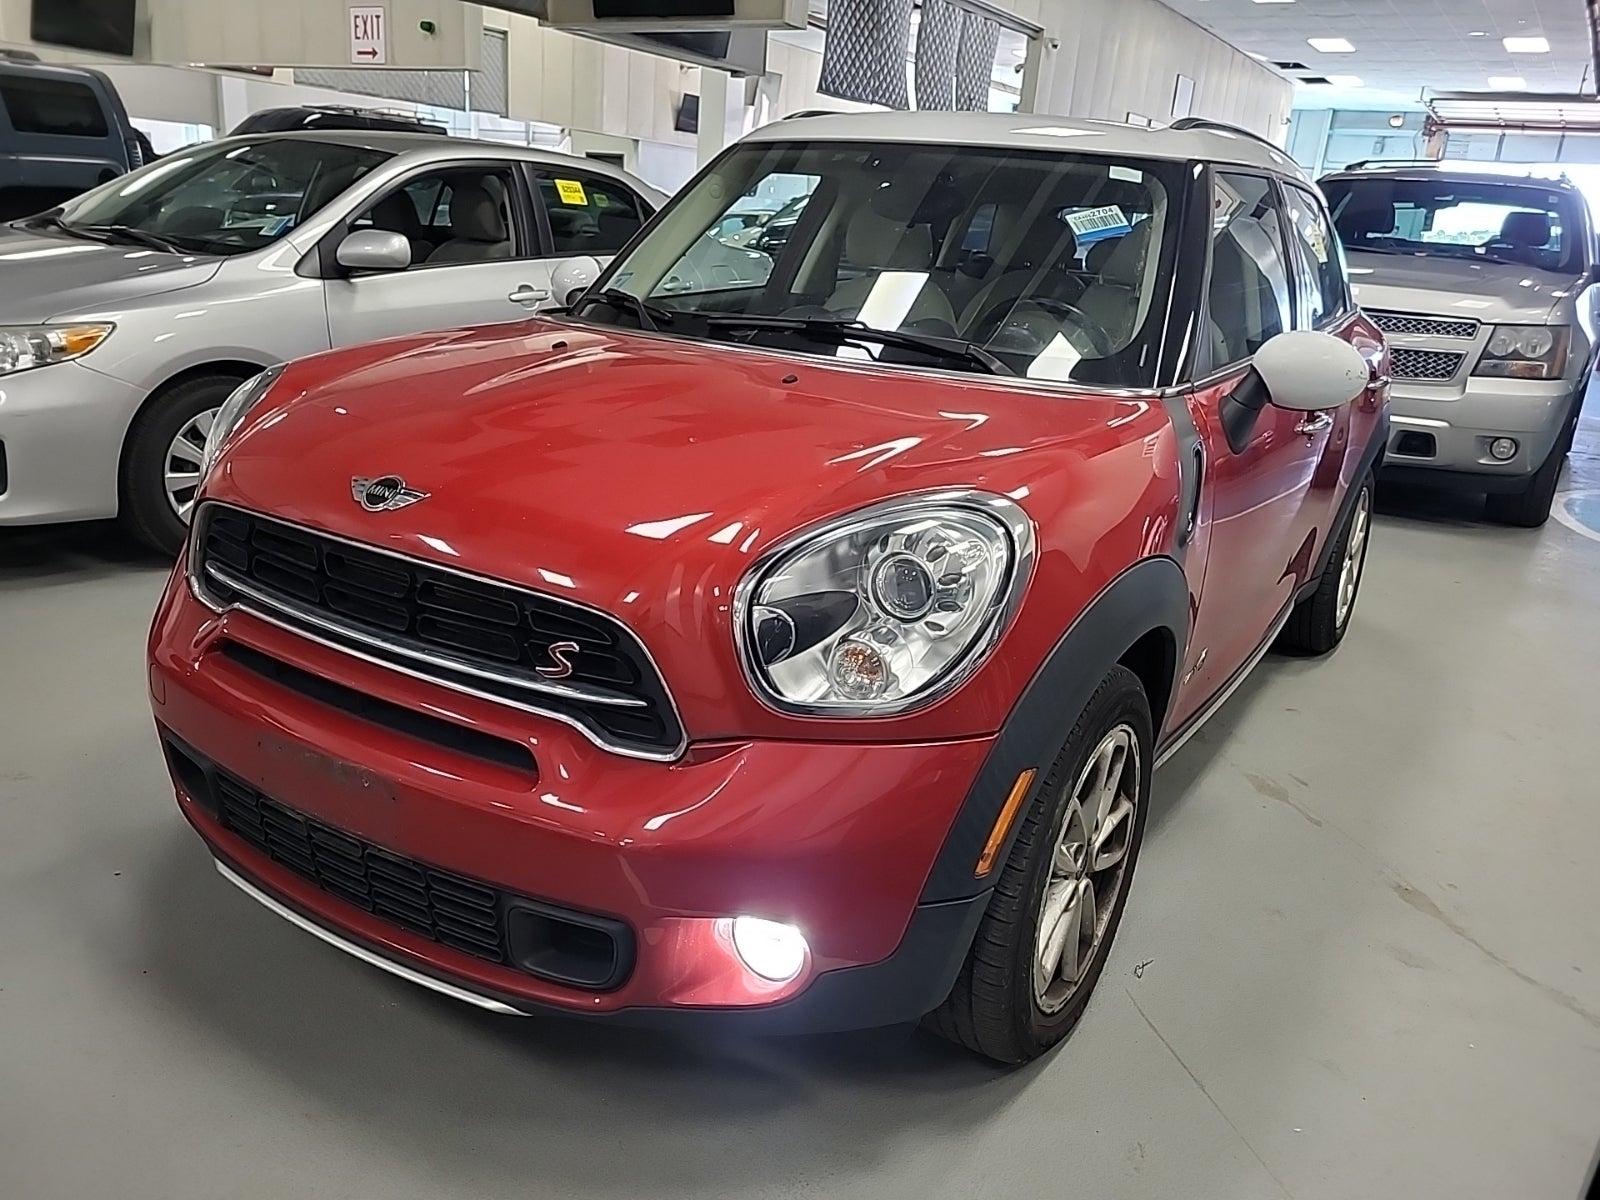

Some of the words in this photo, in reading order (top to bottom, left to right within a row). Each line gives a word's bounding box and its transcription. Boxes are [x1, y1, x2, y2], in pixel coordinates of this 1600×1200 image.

[354, 14, 381, 40] EXIT
[367, 484, 397, 499] MINI
[535, 641, 580, 679] S
